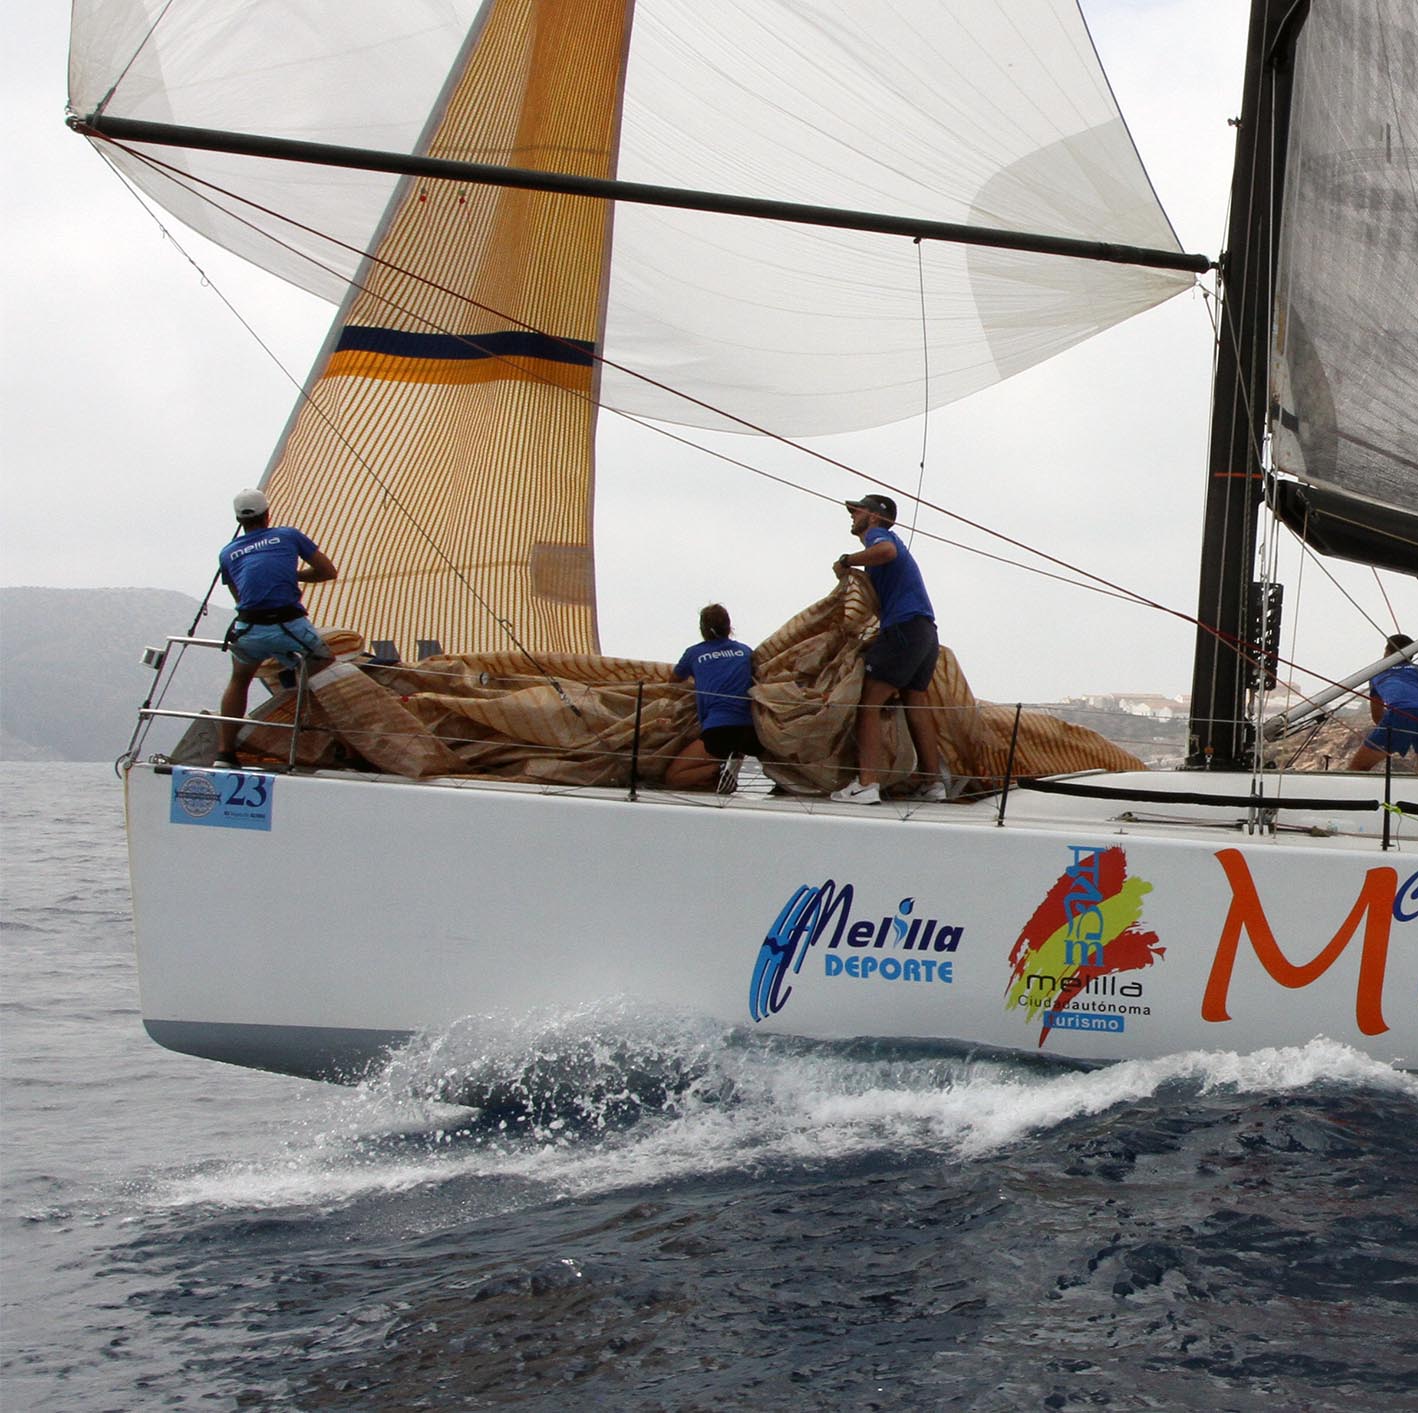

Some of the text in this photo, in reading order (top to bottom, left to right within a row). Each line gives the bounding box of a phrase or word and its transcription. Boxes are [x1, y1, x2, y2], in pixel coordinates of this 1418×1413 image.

[230, 537, 281, 560] melilla
[697, 649, 744, 663] melilla
[226, 773, 267, 807] 23
[772, 879, 965, 1000] Melilla
[824, 954, 953, 984] DEPORTE
[1026, 974, 1143, 998] melilla
[1050, 1014, 1119, 1031] urismo
